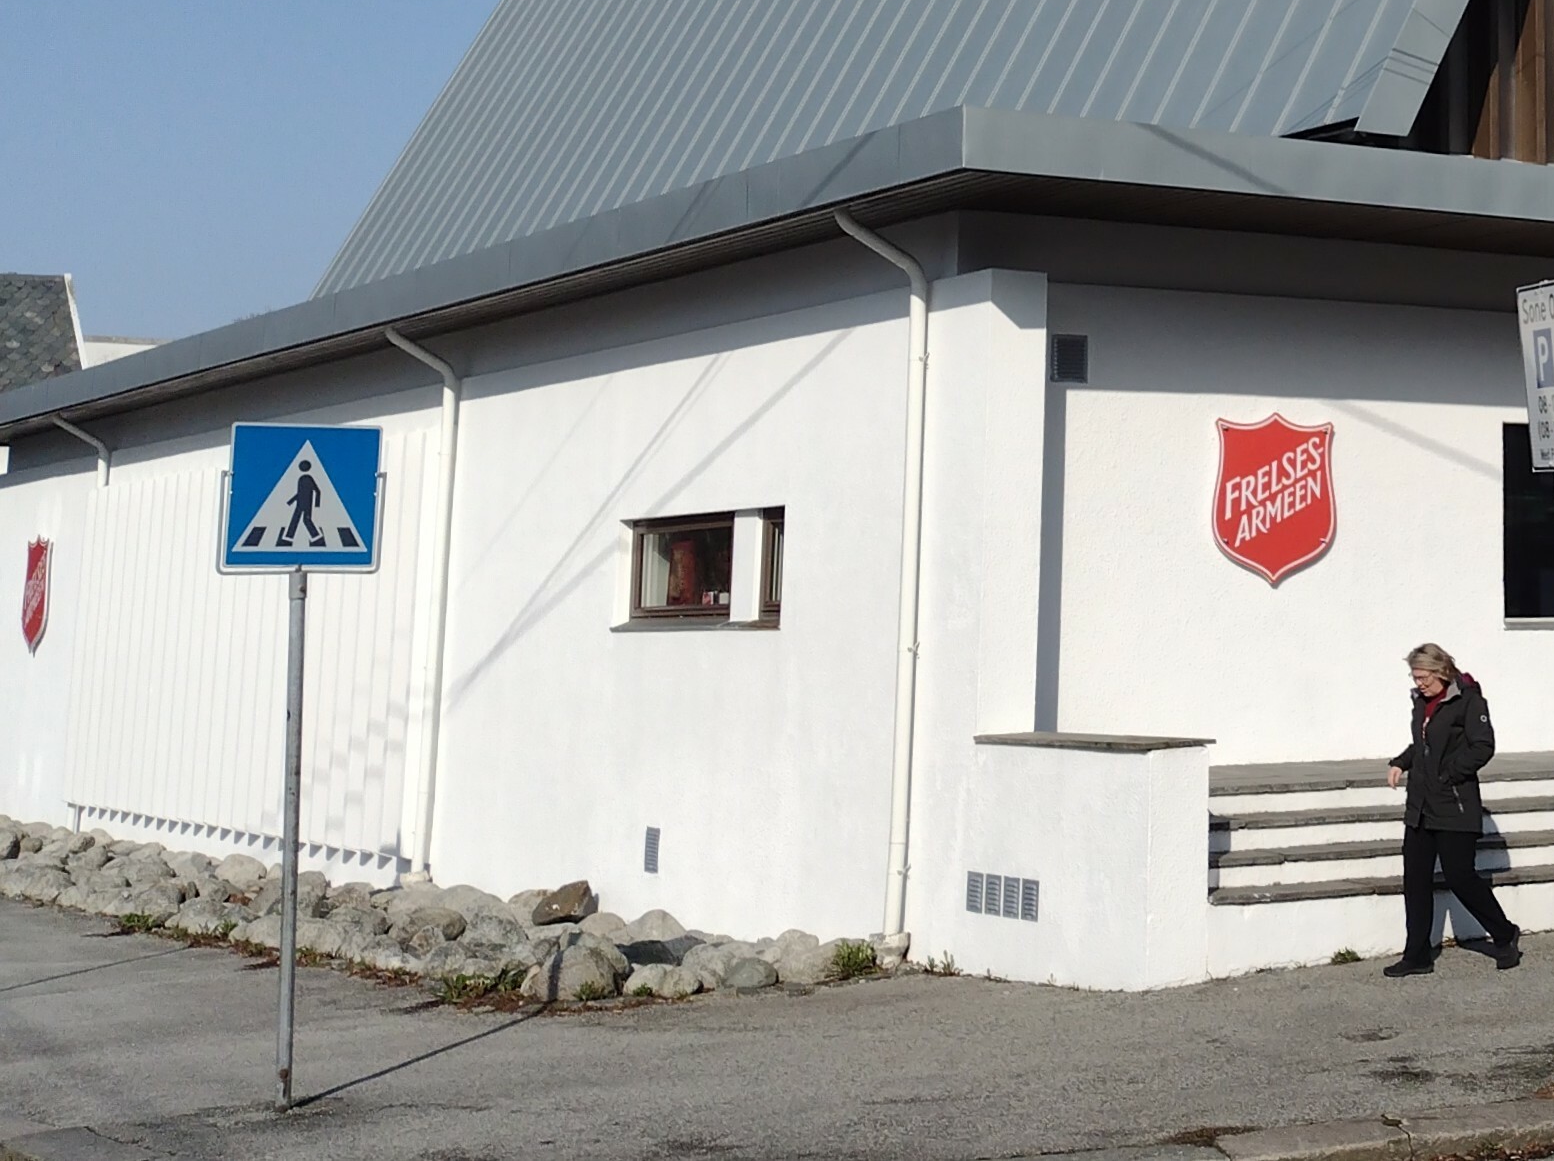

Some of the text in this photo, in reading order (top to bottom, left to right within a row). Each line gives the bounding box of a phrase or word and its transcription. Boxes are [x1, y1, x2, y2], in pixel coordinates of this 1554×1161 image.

[1522, 299, 1546, 325] Sone
[1537, 335, 1549, 382] P
[1225, 437, 1323, 521] FRELSES-
[1235, 471, 1321, 547] ARMEEN
